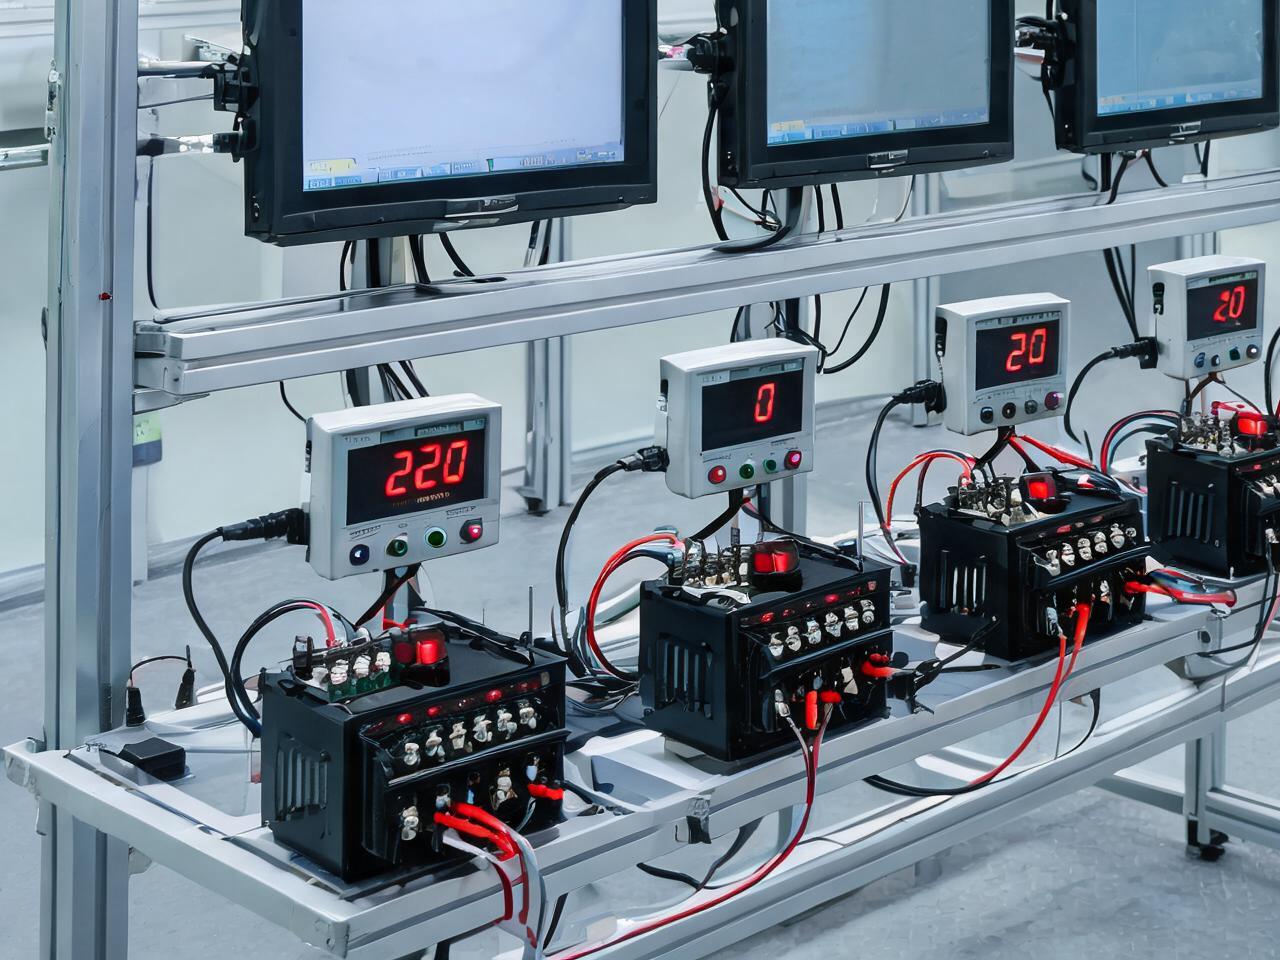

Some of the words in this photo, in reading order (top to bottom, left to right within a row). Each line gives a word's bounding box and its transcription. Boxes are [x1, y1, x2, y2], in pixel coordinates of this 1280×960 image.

[1212, 285, 1246, 322] 20
[1005, 328, 1048, 373] 20
[753, 382, 776, 424] 0
[384, 439, 469, 498] 220
